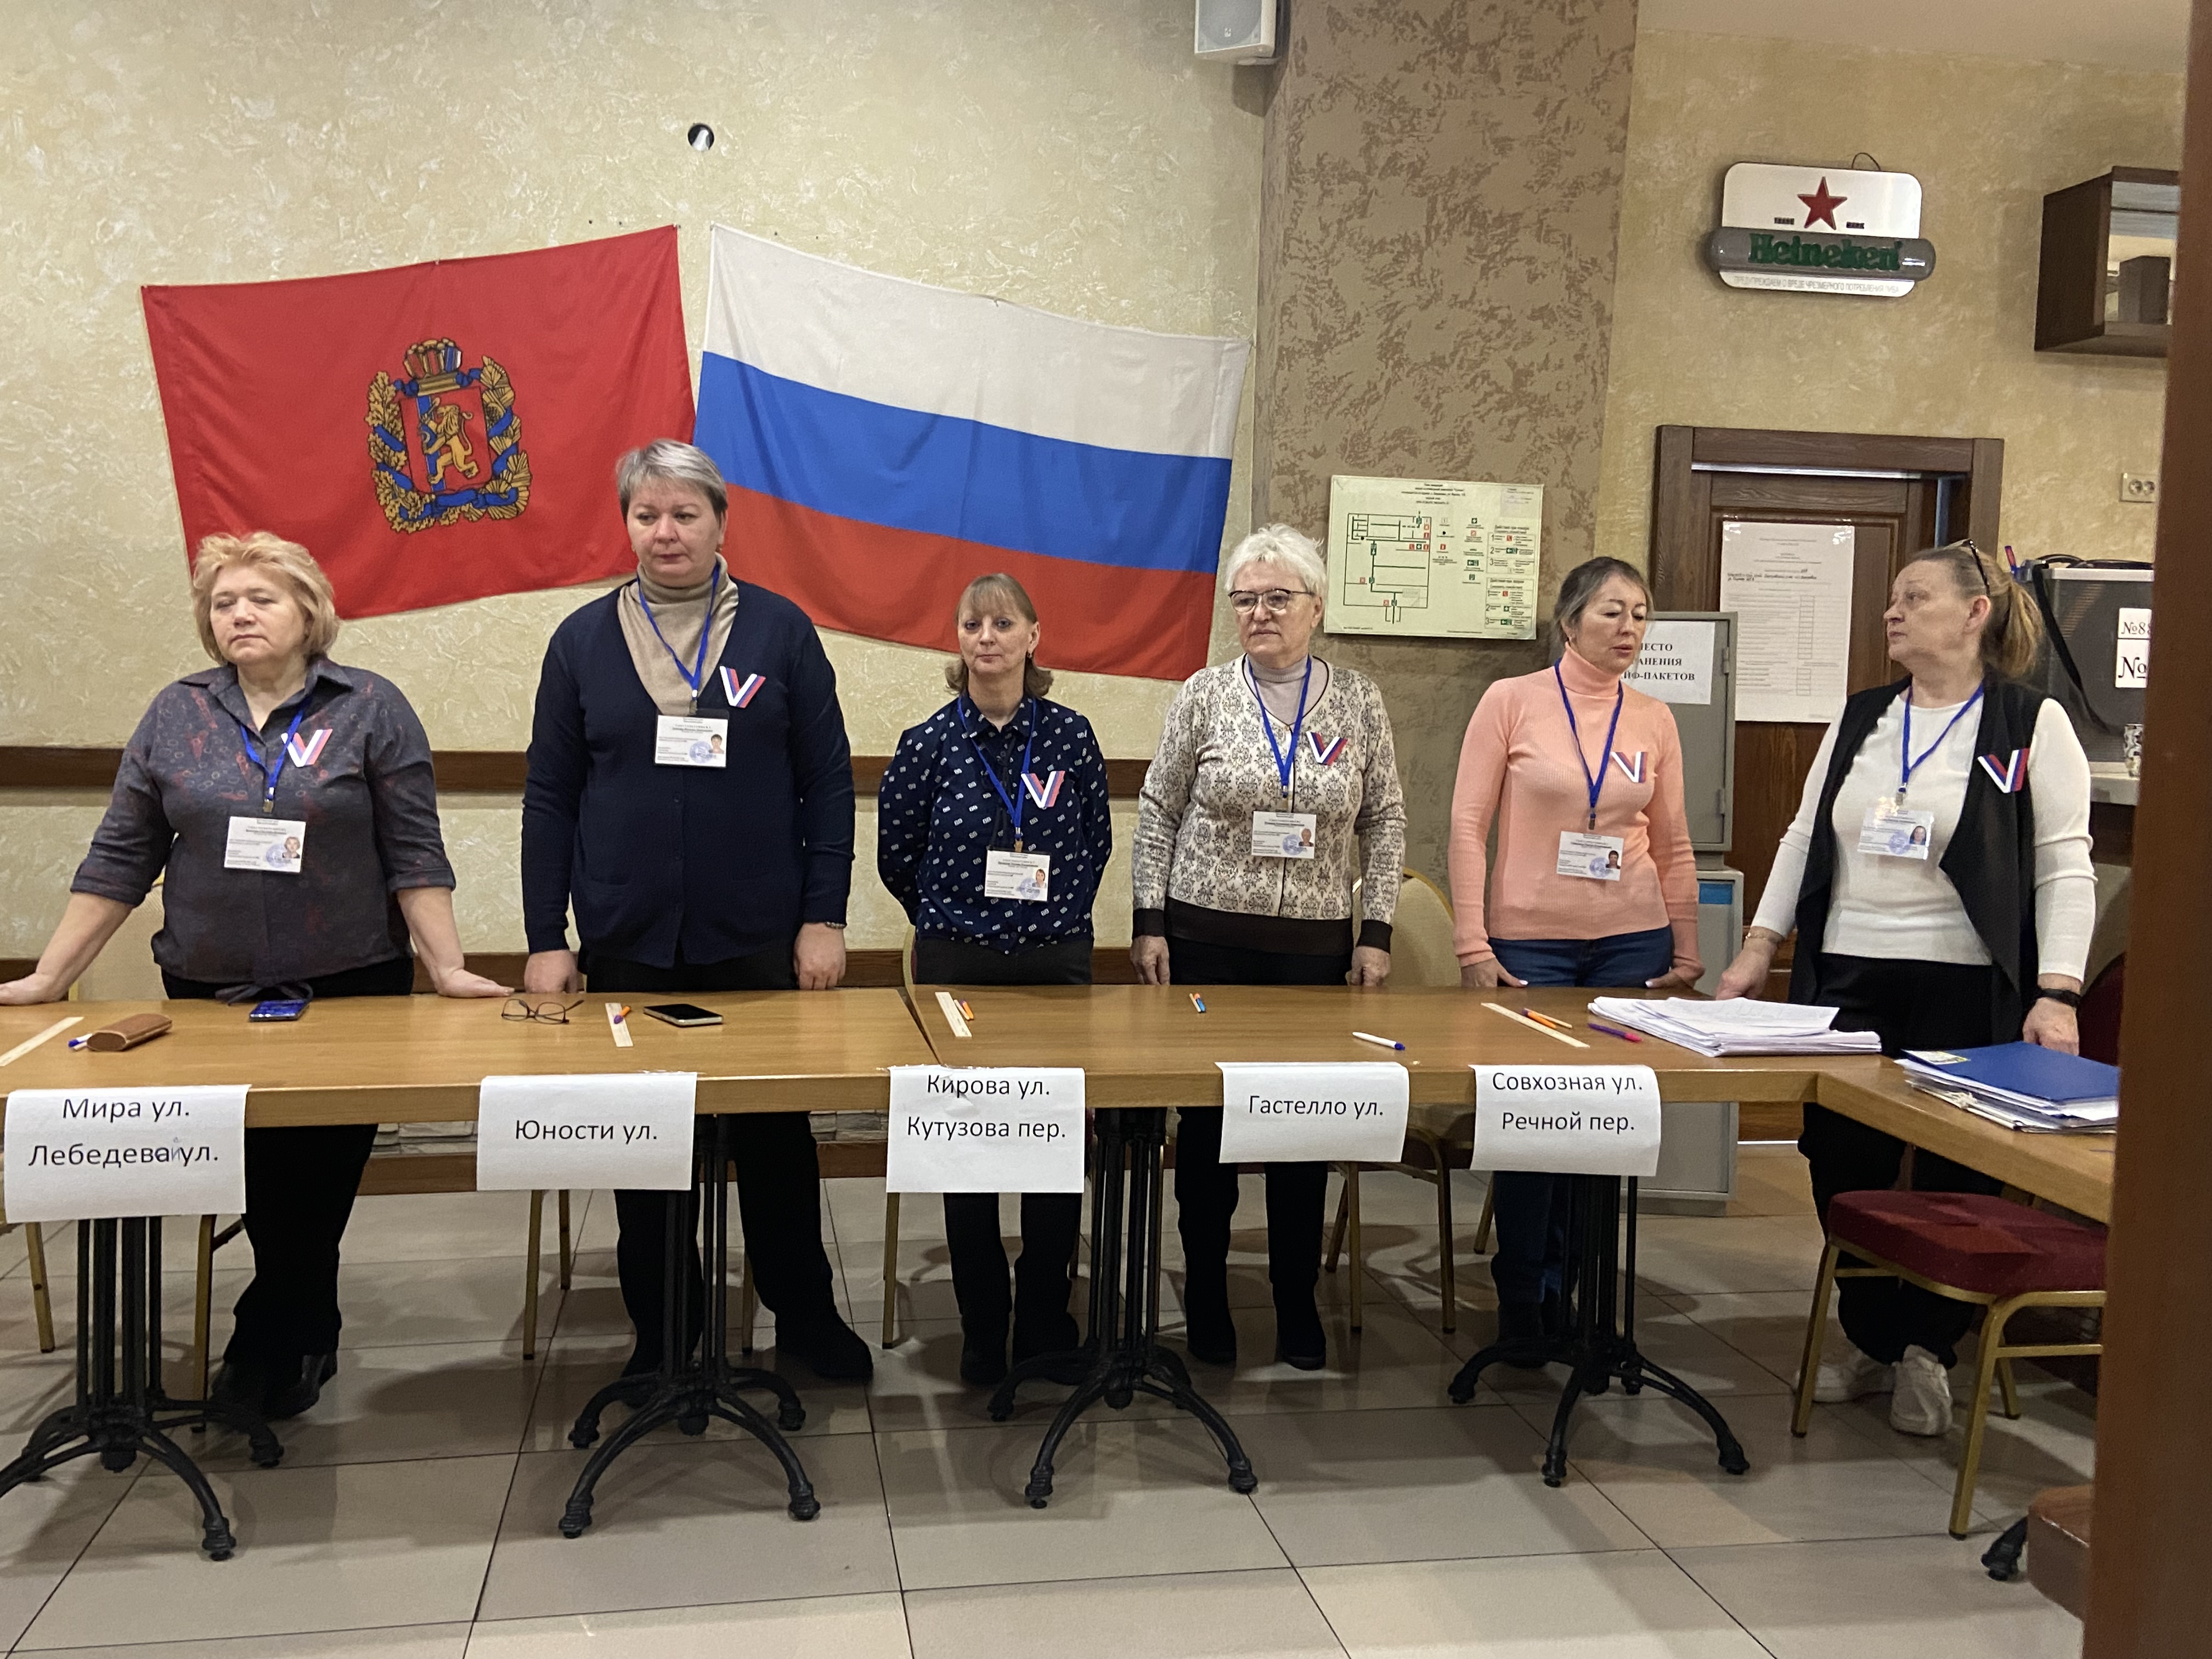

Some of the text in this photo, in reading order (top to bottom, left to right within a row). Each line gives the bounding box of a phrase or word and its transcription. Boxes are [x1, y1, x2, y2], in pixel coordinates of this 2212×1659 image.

[1748, 233, 1903, 271] Heineken
[1623, 670, 1695, 681] ЙФ-ПАКЕТОВ
[927, 1075, 1050, 1099] Кирова ул.
[1492, 1073, 1643, 1095] Совхозная ул.
[62, 1098, 190, 1123] Мира ул.
[1249, 1095, 1384, 1120] Гастелло ул.
[515, 1120, 658, 1145] Юности ул.
[907, 1116, 1066, 1142] Кутузова пер.
[1502, 1110, 1634, 1135] Речной пер.
[179, 1146, 218, 1167] ул.
